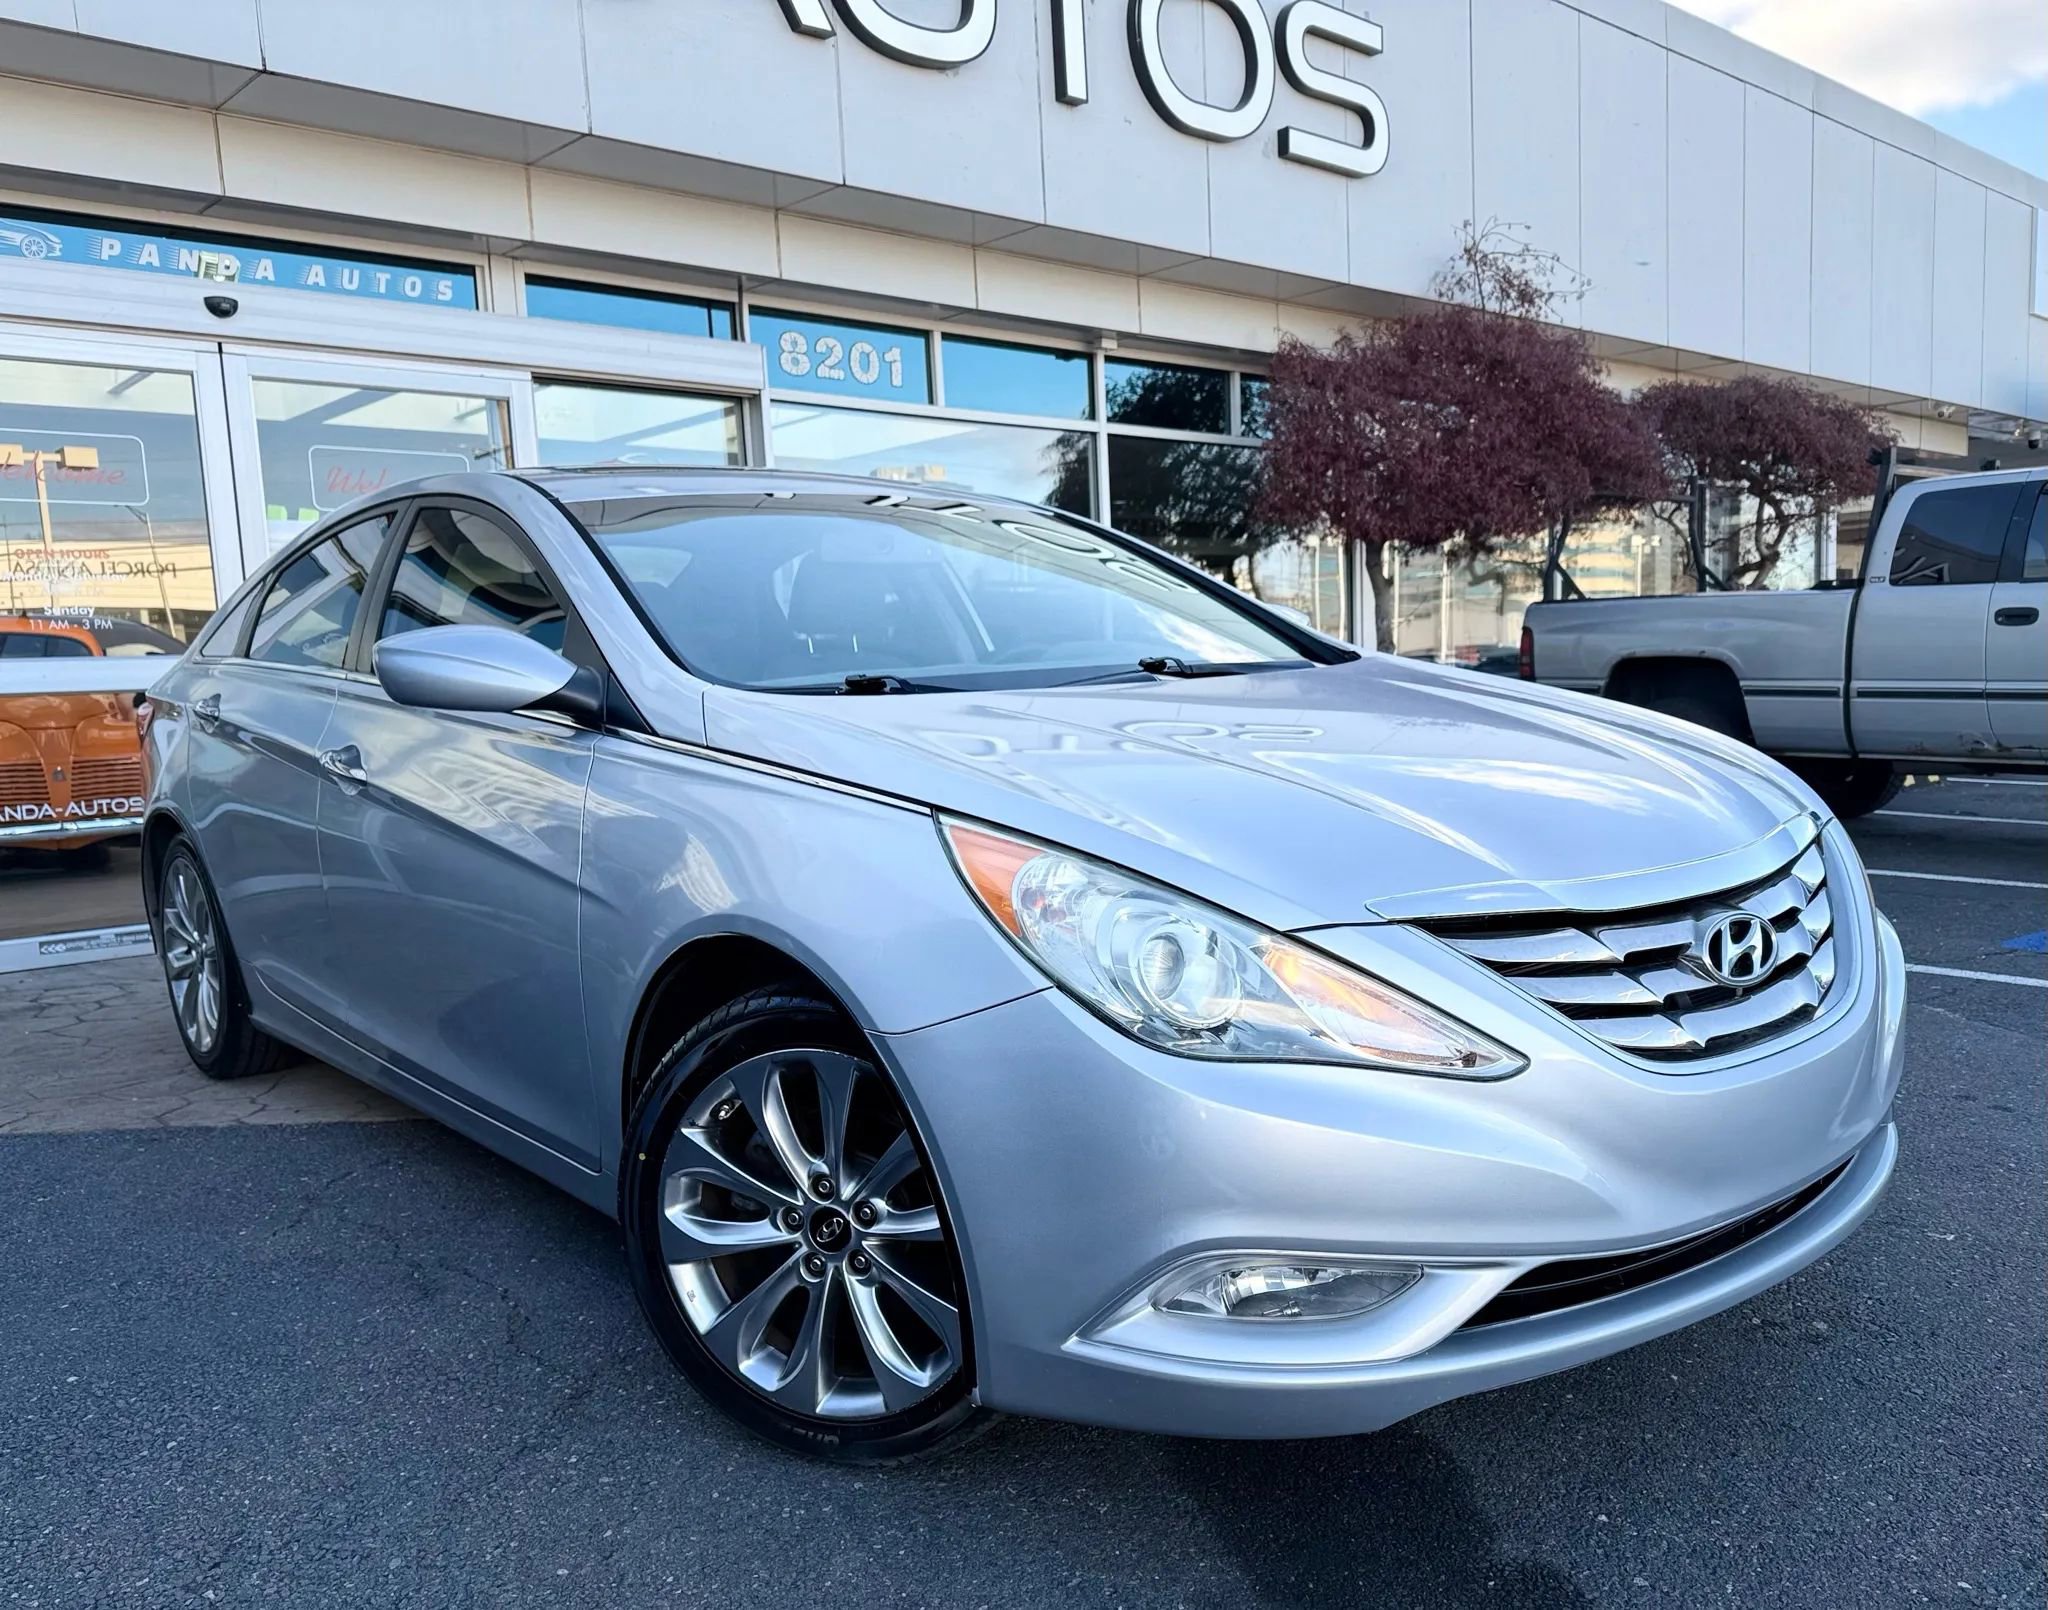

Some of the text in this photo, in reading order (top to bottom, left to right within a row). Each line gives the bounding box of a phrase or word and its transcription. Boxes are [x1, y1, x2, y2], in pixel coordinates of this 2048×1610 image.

[100, 237, 453, 301] PANDA AUTOS
[779, 330, 903, 388] 8201
[15, 549, 110, 560] OPEN HOURS
[43, 606, 96, 617] Sunday
[30, 619, 44, 631] 11
[48, 619, 70, 630] AM
[82, 618, 91, 630] 3
[94, 618, 113, 630] PM
[0, 796, 145, 822] NDA-AUTOS
